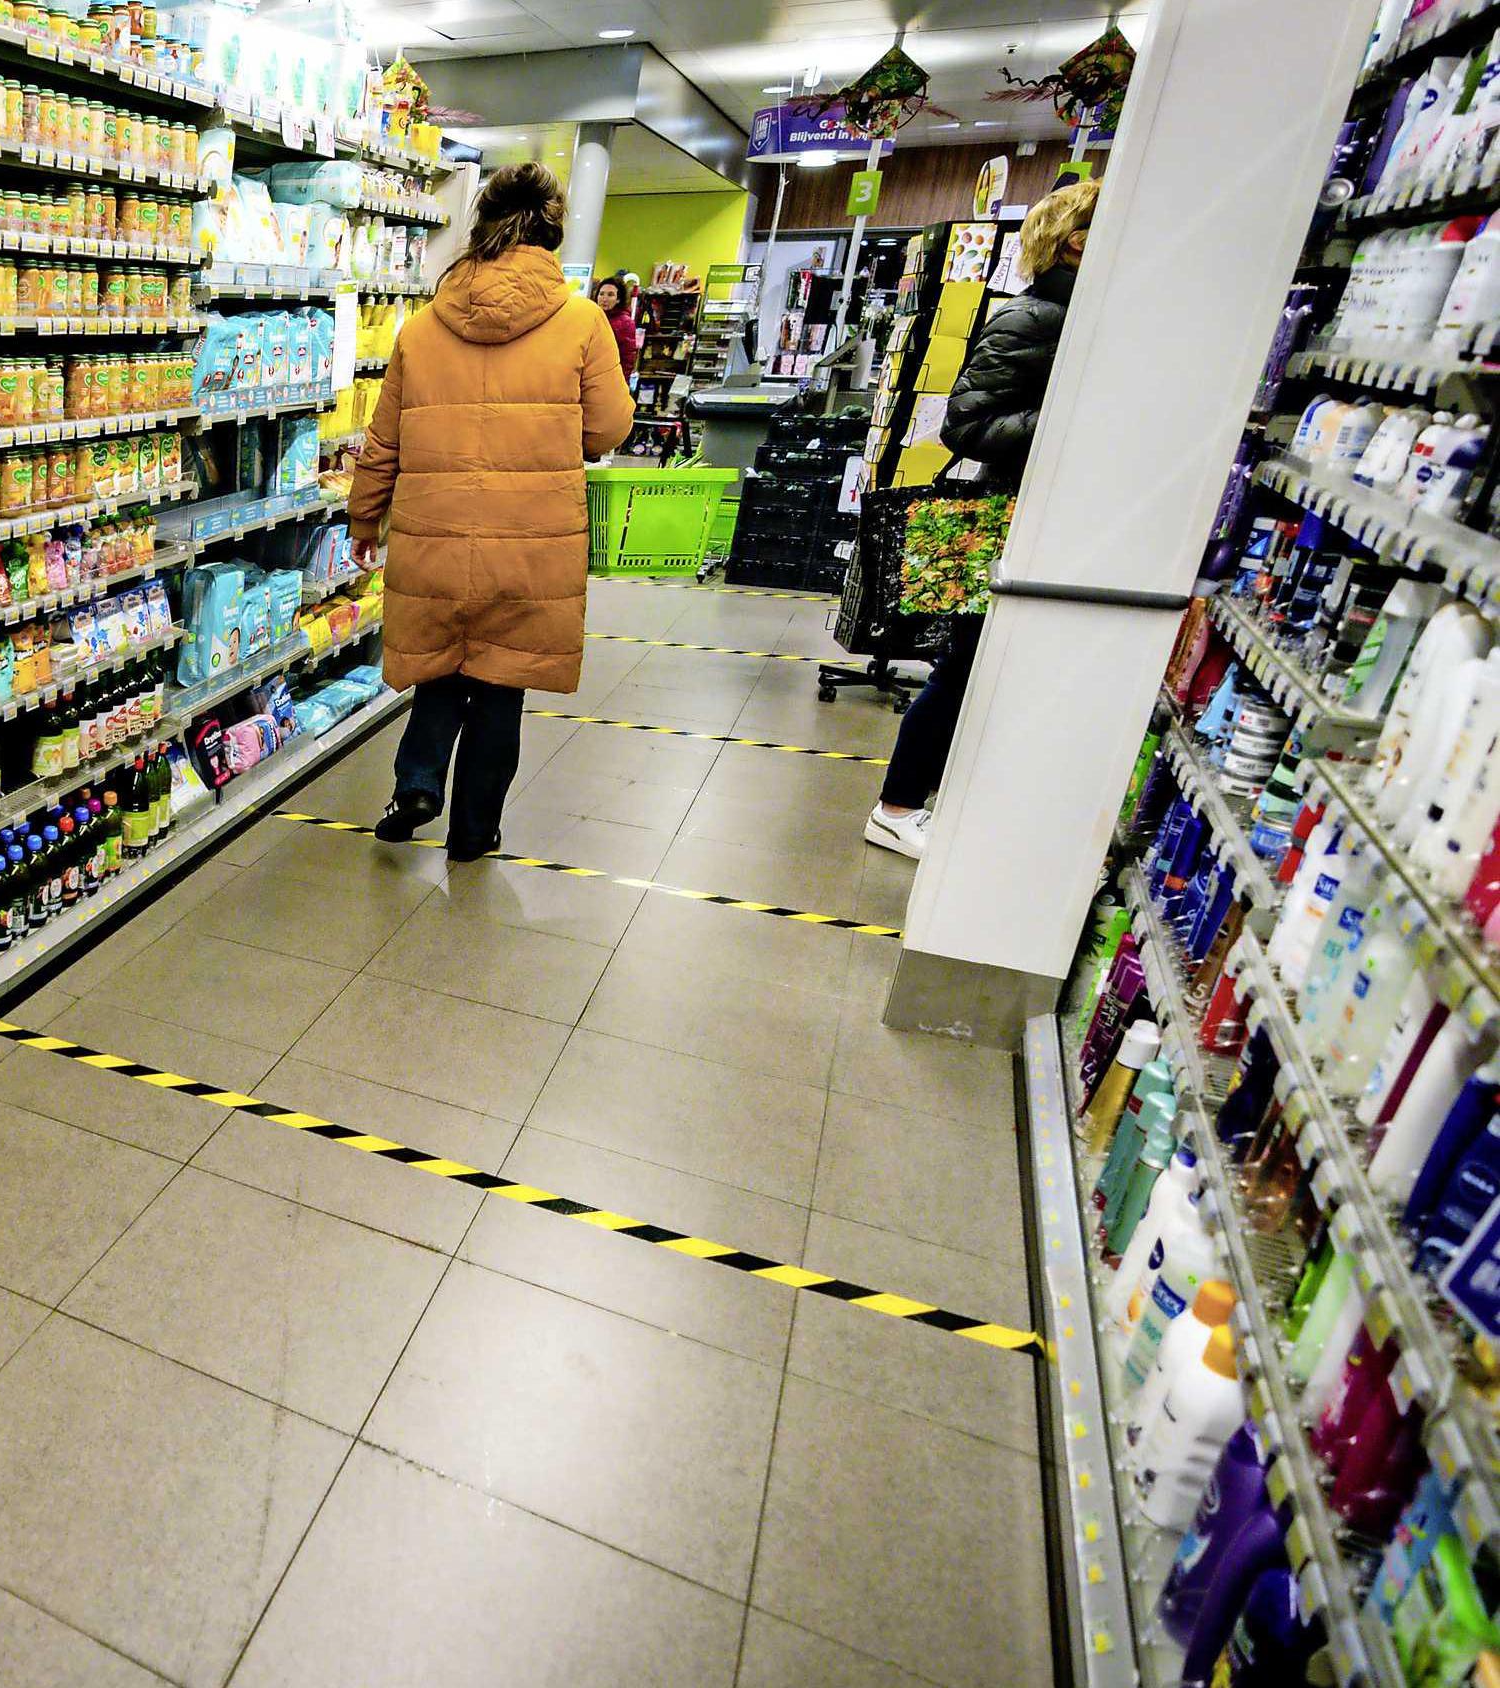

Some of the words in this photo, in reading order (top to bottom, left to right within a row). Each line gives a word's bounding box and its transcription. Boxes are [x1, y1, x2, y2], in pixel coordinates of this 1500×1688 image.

[790, 130, 836, 142] Blijvend
[839, 131, 849, 140] in
[856, 181, 873, 202] 3
[1193, 983, 1208, 1000] 5
